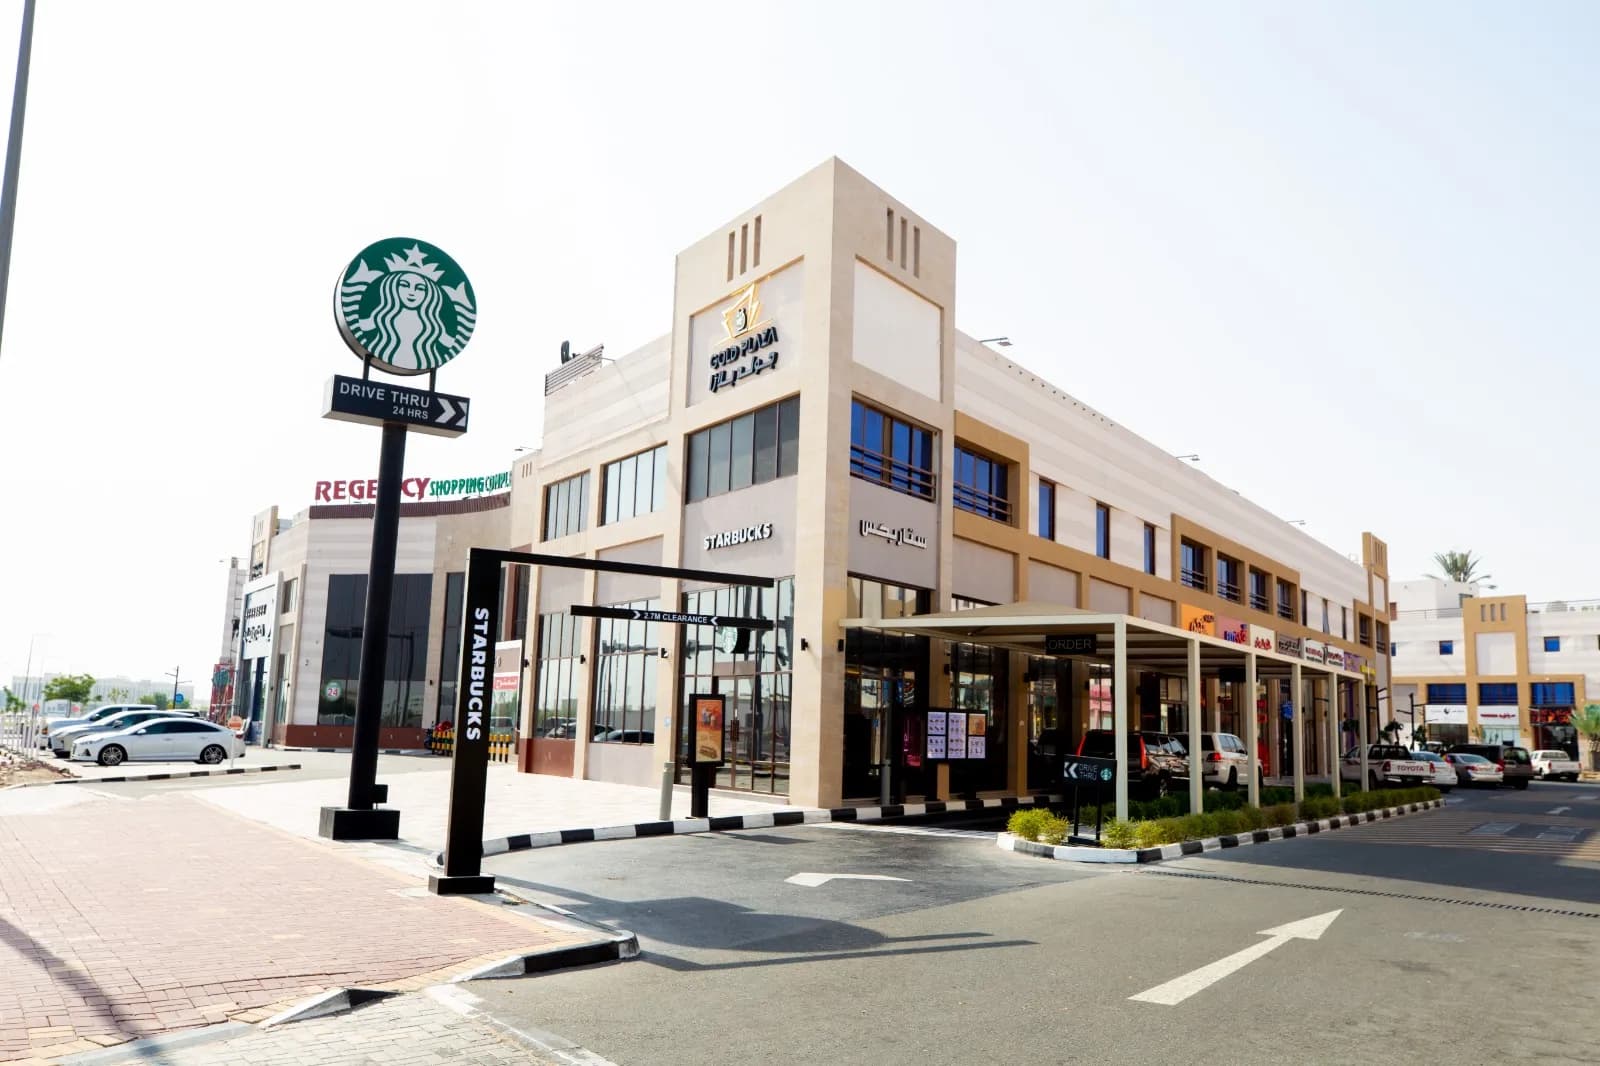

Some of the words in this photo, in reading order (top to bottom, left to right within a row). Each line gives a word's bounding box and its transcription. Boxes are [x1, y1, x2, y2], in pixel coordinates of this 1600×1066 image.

[710, 345, 741, 370] GOLD
[741, 326, 779, 357] PLAZA
[339, 381, 386, 401] DRIVE
[390, 390, 430, 409] THRU
[392, 405, 405, 417] 24
[407, 407, 429, 420] HRS
[314, 477, 431, 503] REGECY
[429, 476, 484, 497] SHOPPING
[485, 471, 512, 491] COMPL
[703, 522, 773, 551] STARBUCKS
[859, 519, 927, 549] ستاربكس
[643, 612, 661, 620] 2.7M
[662, 613, 708, 624] CLEARANCE
[1048, 638, 1092, 650] ORDER
[466, 607, 490, 741] STARBUCKS
[327, 687, 338, 697] 24
[1078, 763, 1098, 773] DRIVE
[1396, 764, 1424, 773] TOYOTA
[1079, 771, 1097, 781] THRU
